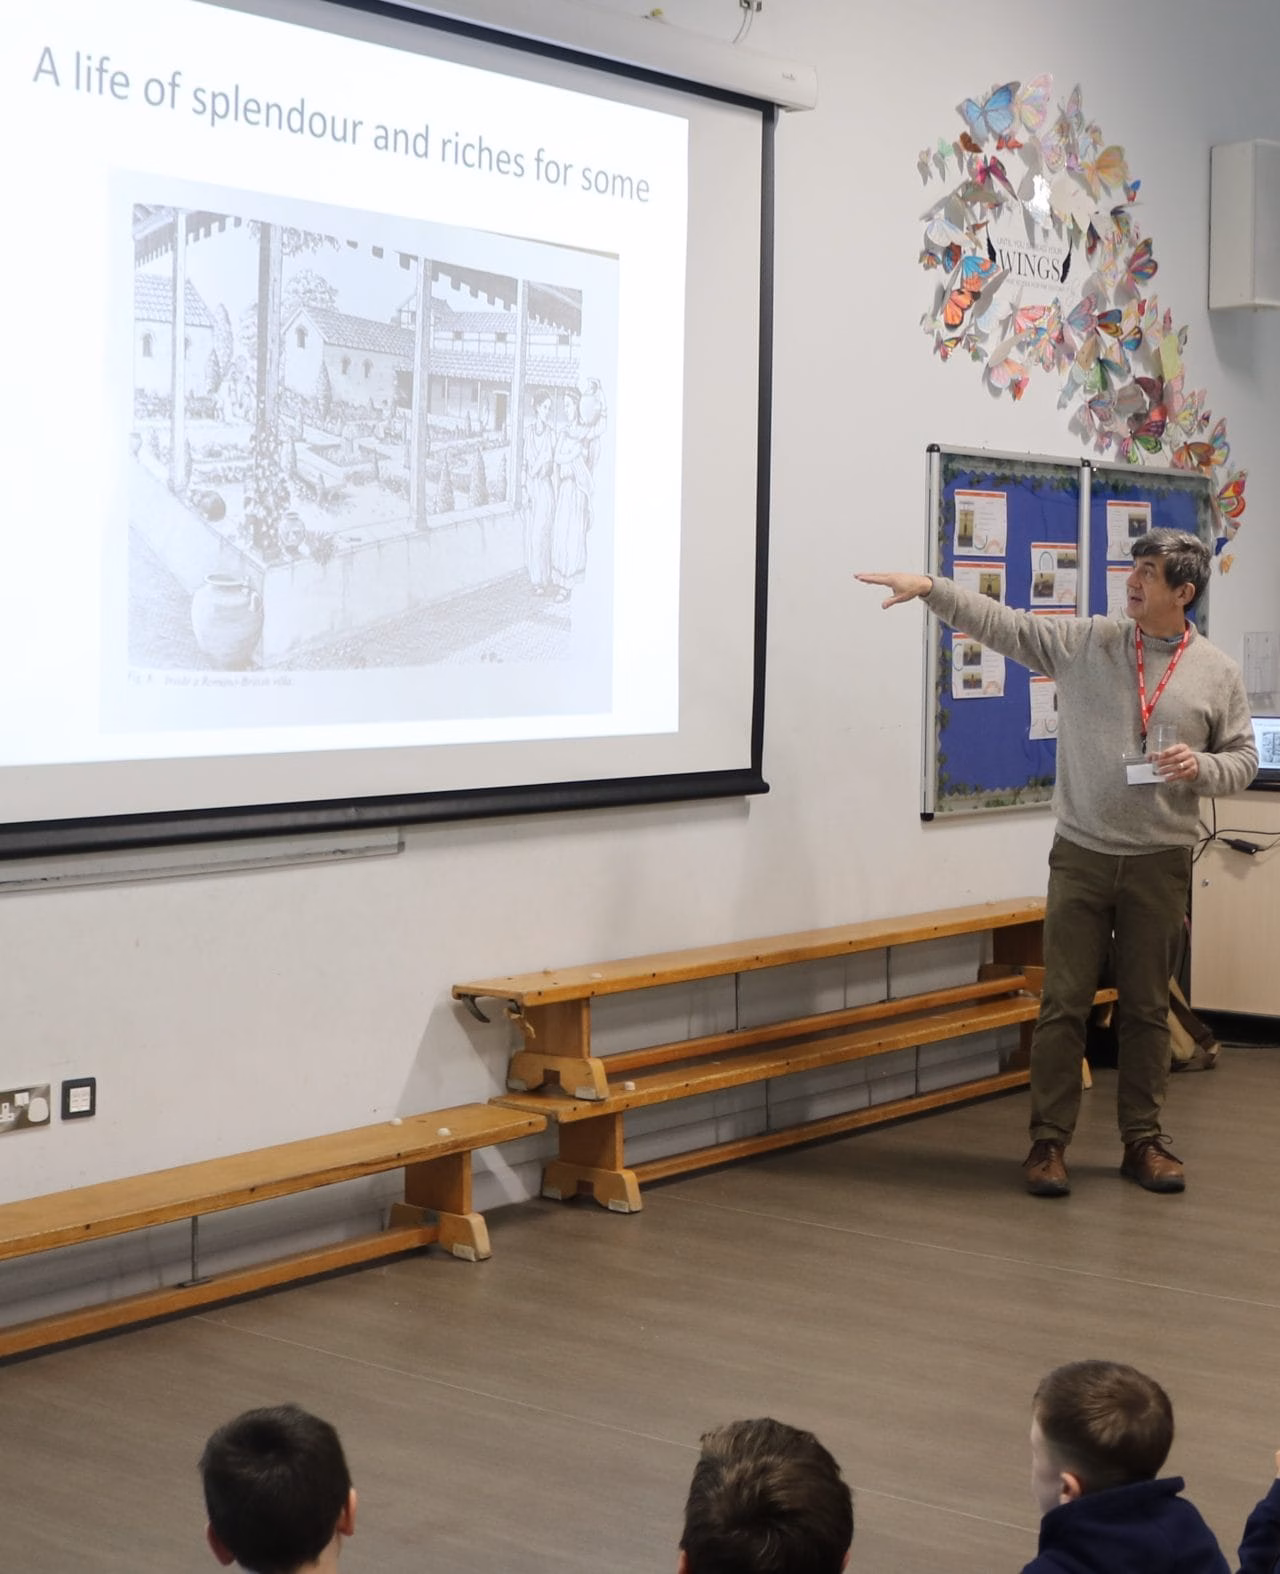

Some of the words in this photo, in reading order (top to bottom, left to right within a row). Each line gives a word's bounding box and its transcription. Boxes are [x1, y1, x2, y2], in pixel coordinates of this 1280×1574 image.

[32, 46, 61, 87] A
[75, 50, 130, 101] life
[143, 70, 182, 110] of
[191, 83, 364, 145] splendour
[373, 124, 430, 159] and
[441, 134, 525, 178] riches
[534, 147, 574, 186] for
[581, 167, 651, 203] some
[999, 248, 1061, 282] WINGS
